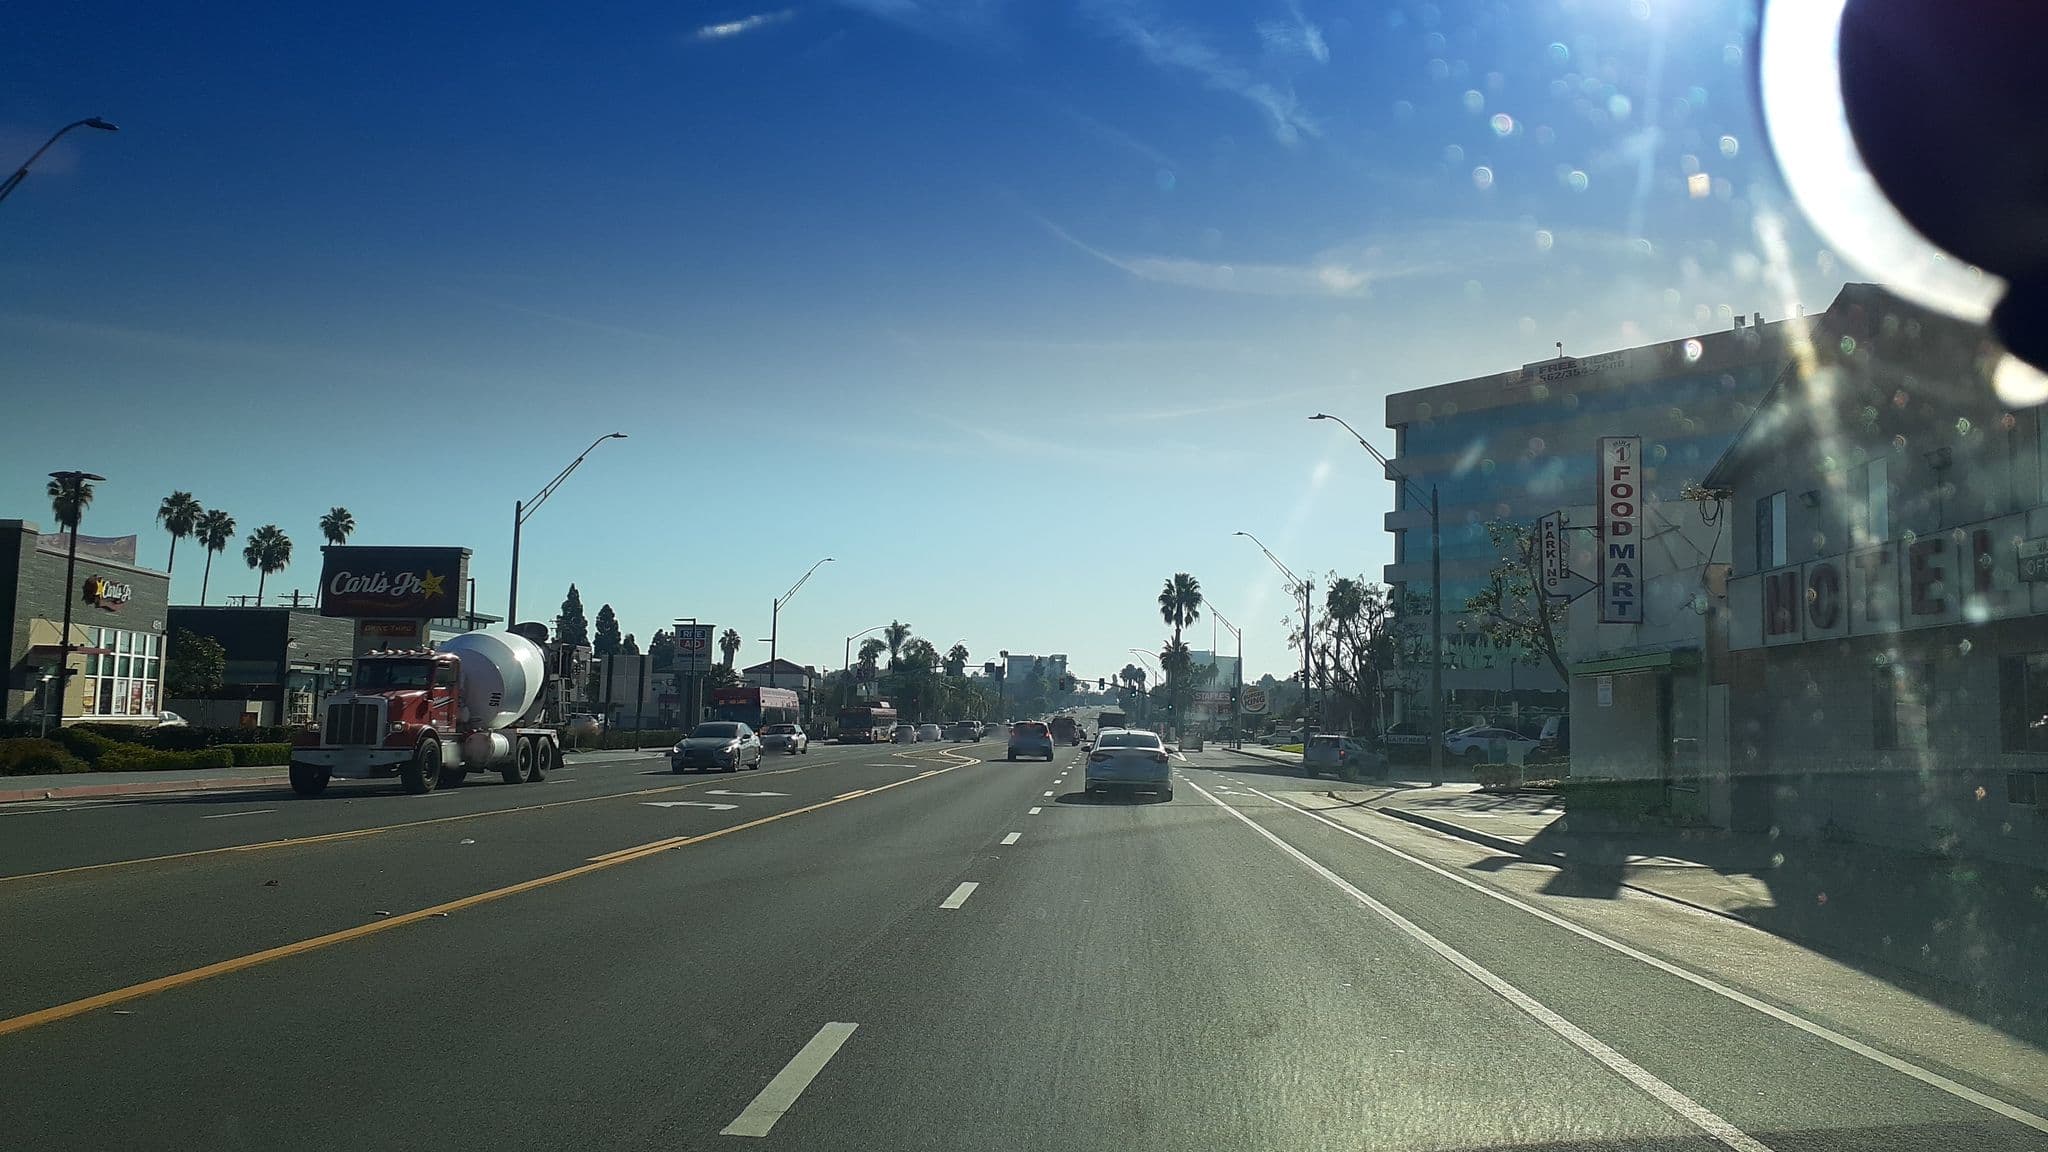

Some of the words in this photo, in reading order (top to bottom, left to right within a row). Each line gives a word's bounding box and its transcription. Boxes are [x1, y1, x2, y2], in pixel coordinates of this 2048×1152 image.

[1538, 360, 1578, 374] FREE
[1610, 466, 1633, 536] FOOD
[1545, 522, 1557, 587] PARKING
[330, 571, 391, 595] Carl's
[1609, 543, 1635, 616] MART
[1766, 529, 2009, 635] MOTEL
[683, 630, 705, 638] RIE
[1195, 692, 1231, 702] STAPLES
